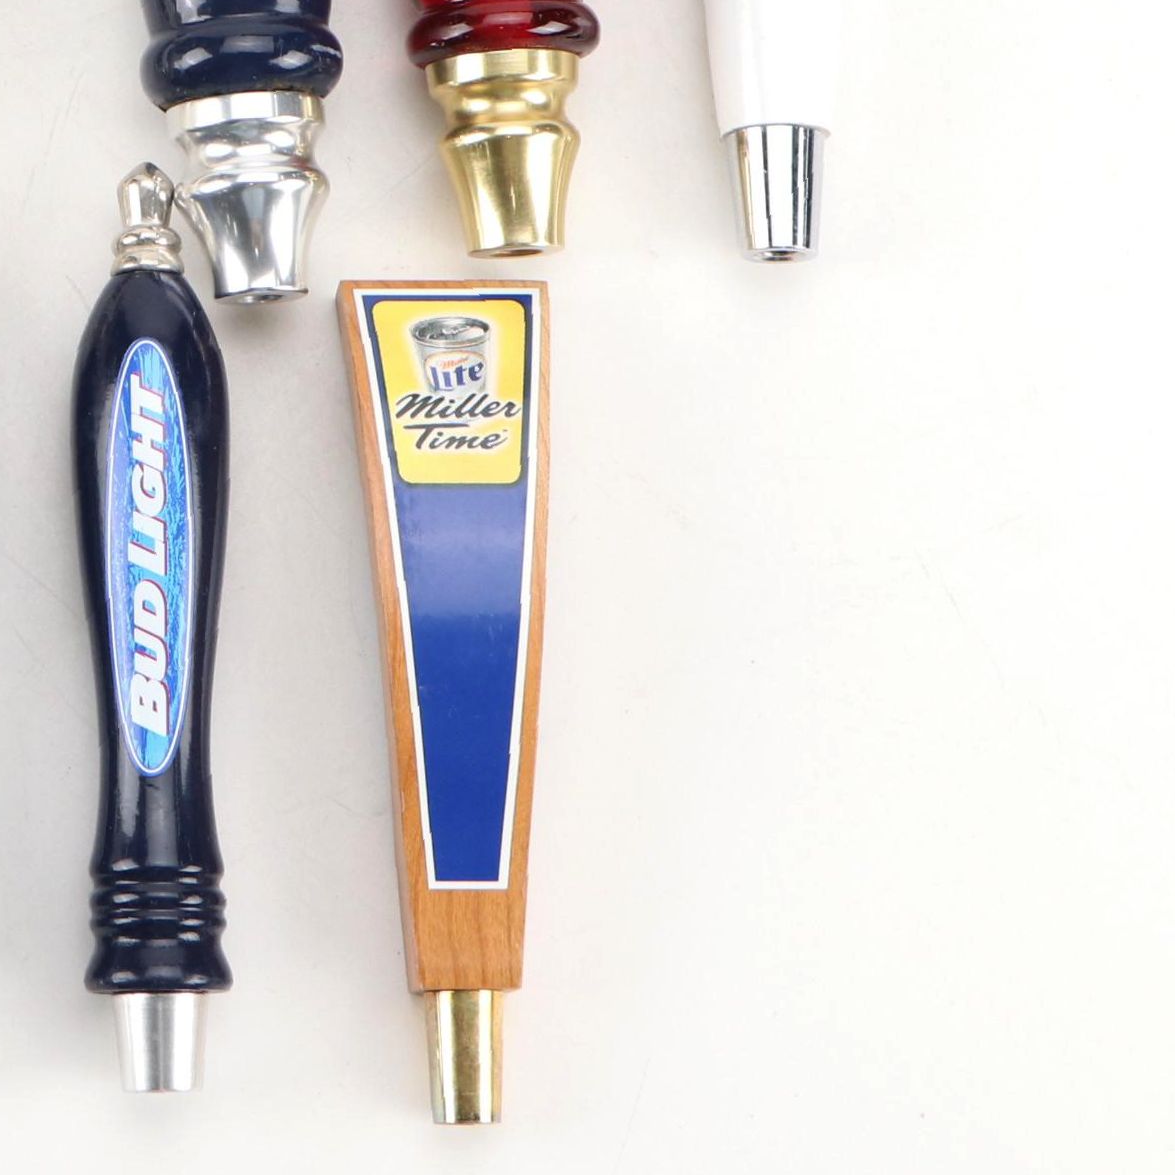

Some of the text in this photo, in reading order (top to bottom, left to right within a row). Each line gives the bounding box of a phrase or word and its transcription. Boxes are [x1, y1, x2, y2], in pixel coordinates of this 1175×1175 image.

[395, 393, 522, 420] Miller
[403, 422, 508, 451] Time
[128, 371, 171, 736] BUD LIGHT
